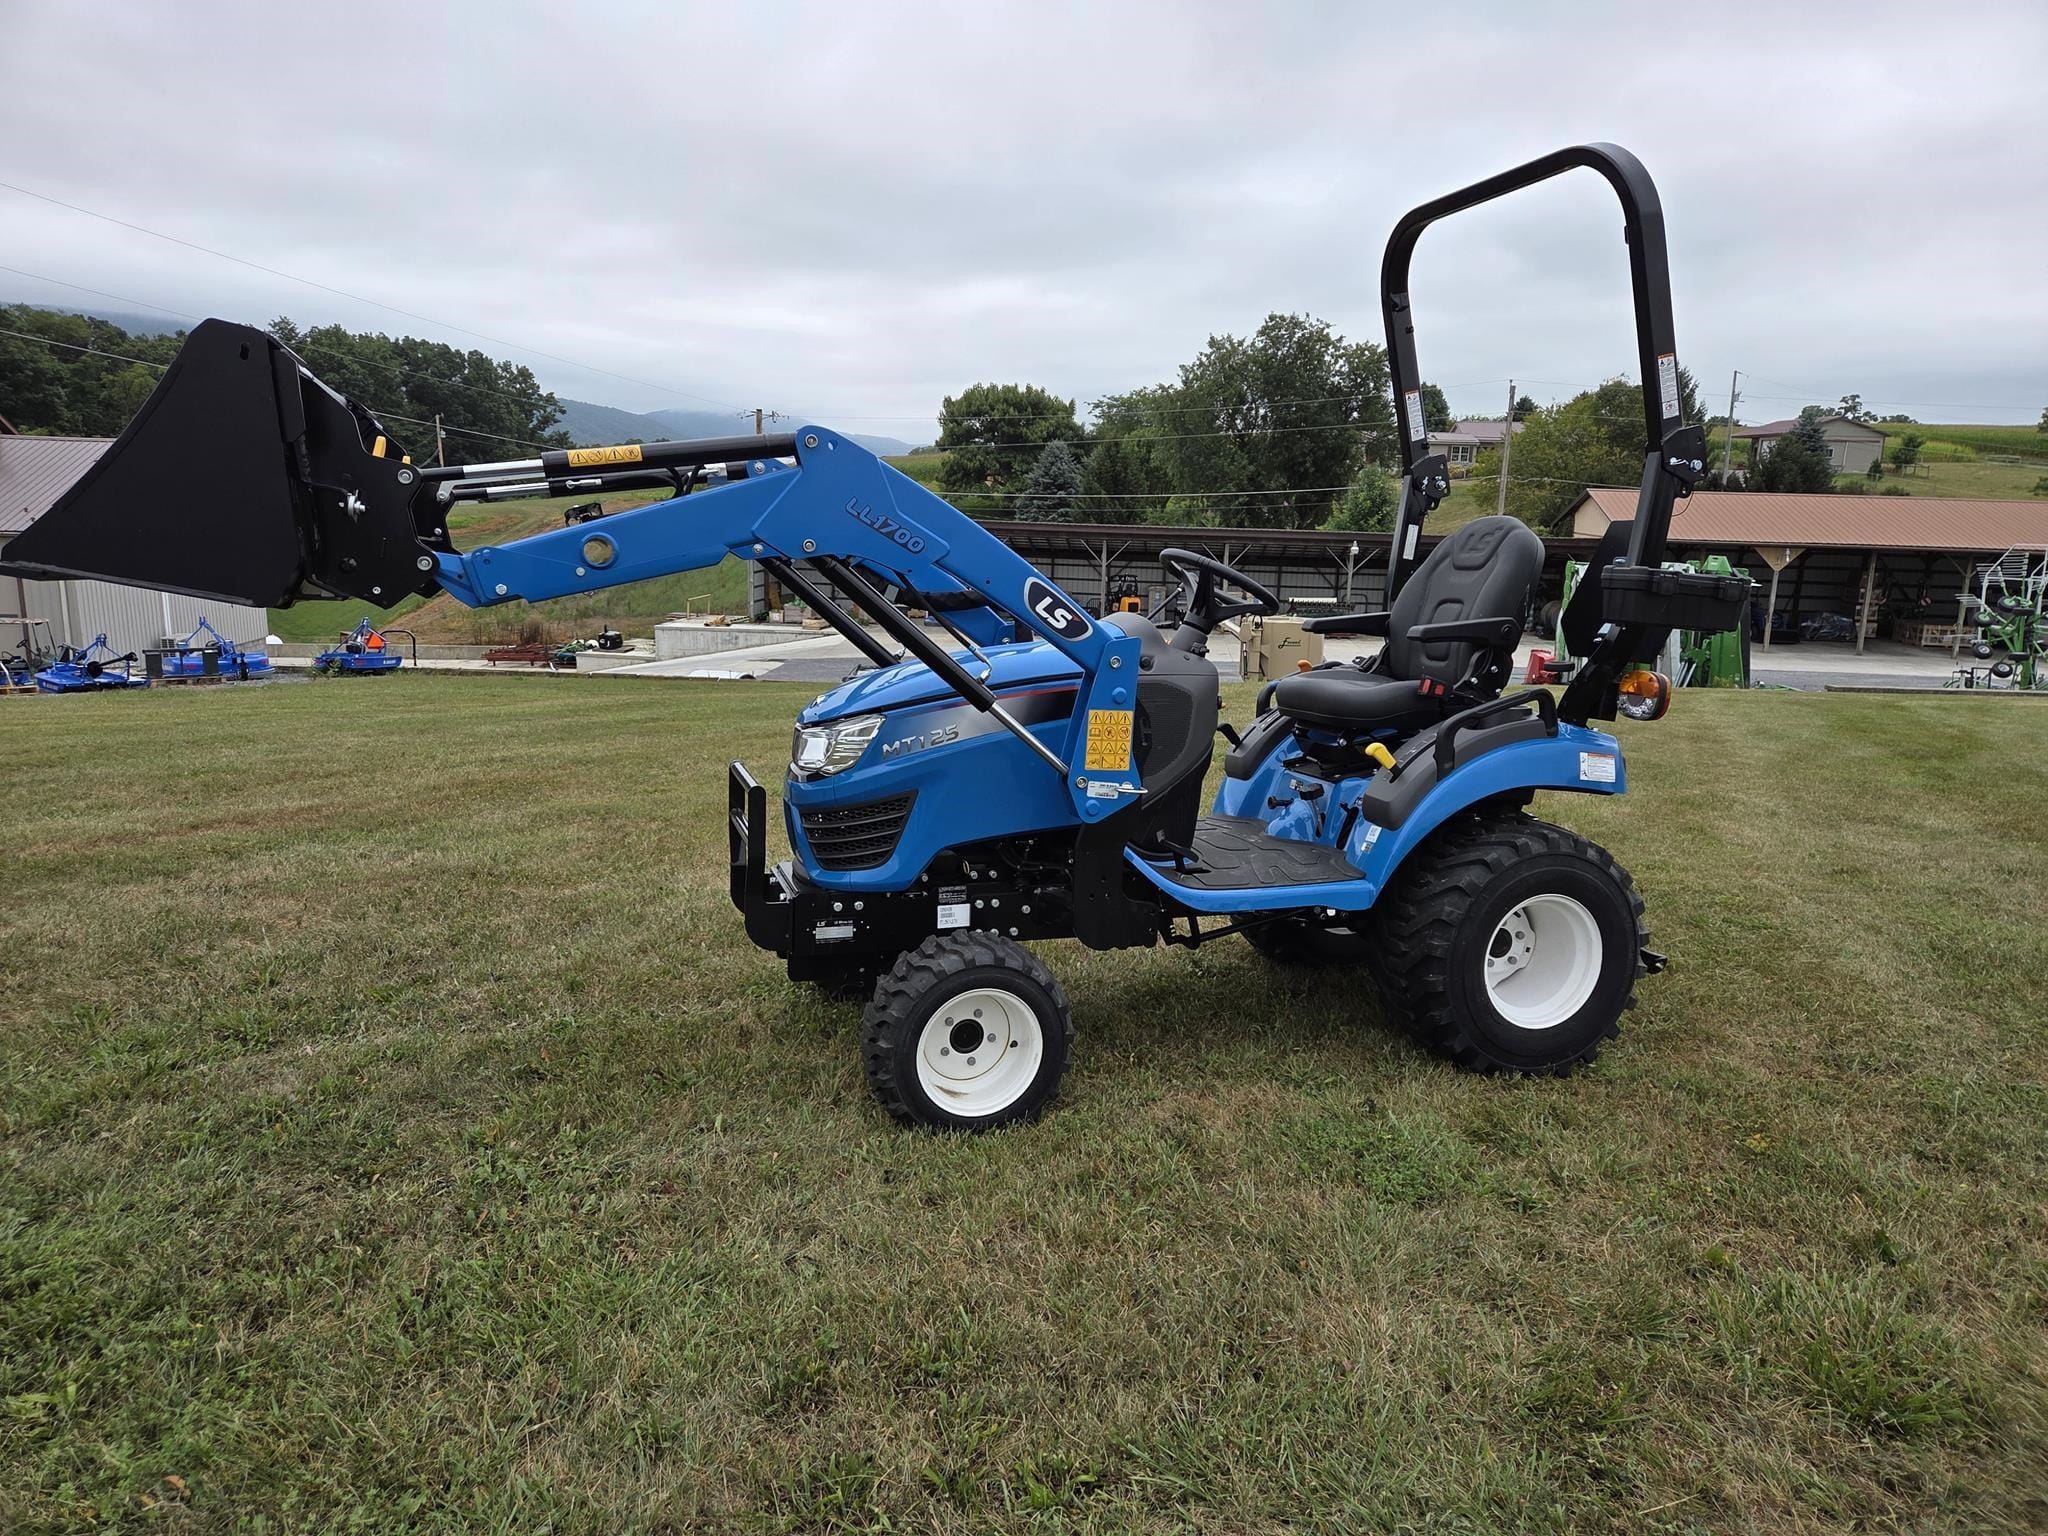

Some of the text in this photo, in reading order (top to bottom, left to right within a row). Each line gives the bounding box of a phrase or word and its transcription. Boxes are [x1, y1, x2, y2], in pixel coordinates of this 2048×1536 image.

[845, 496, 926, 555] LL1700
[1034, 595, 1074, 630] LS
[882, 724, 960, 760] MT125
